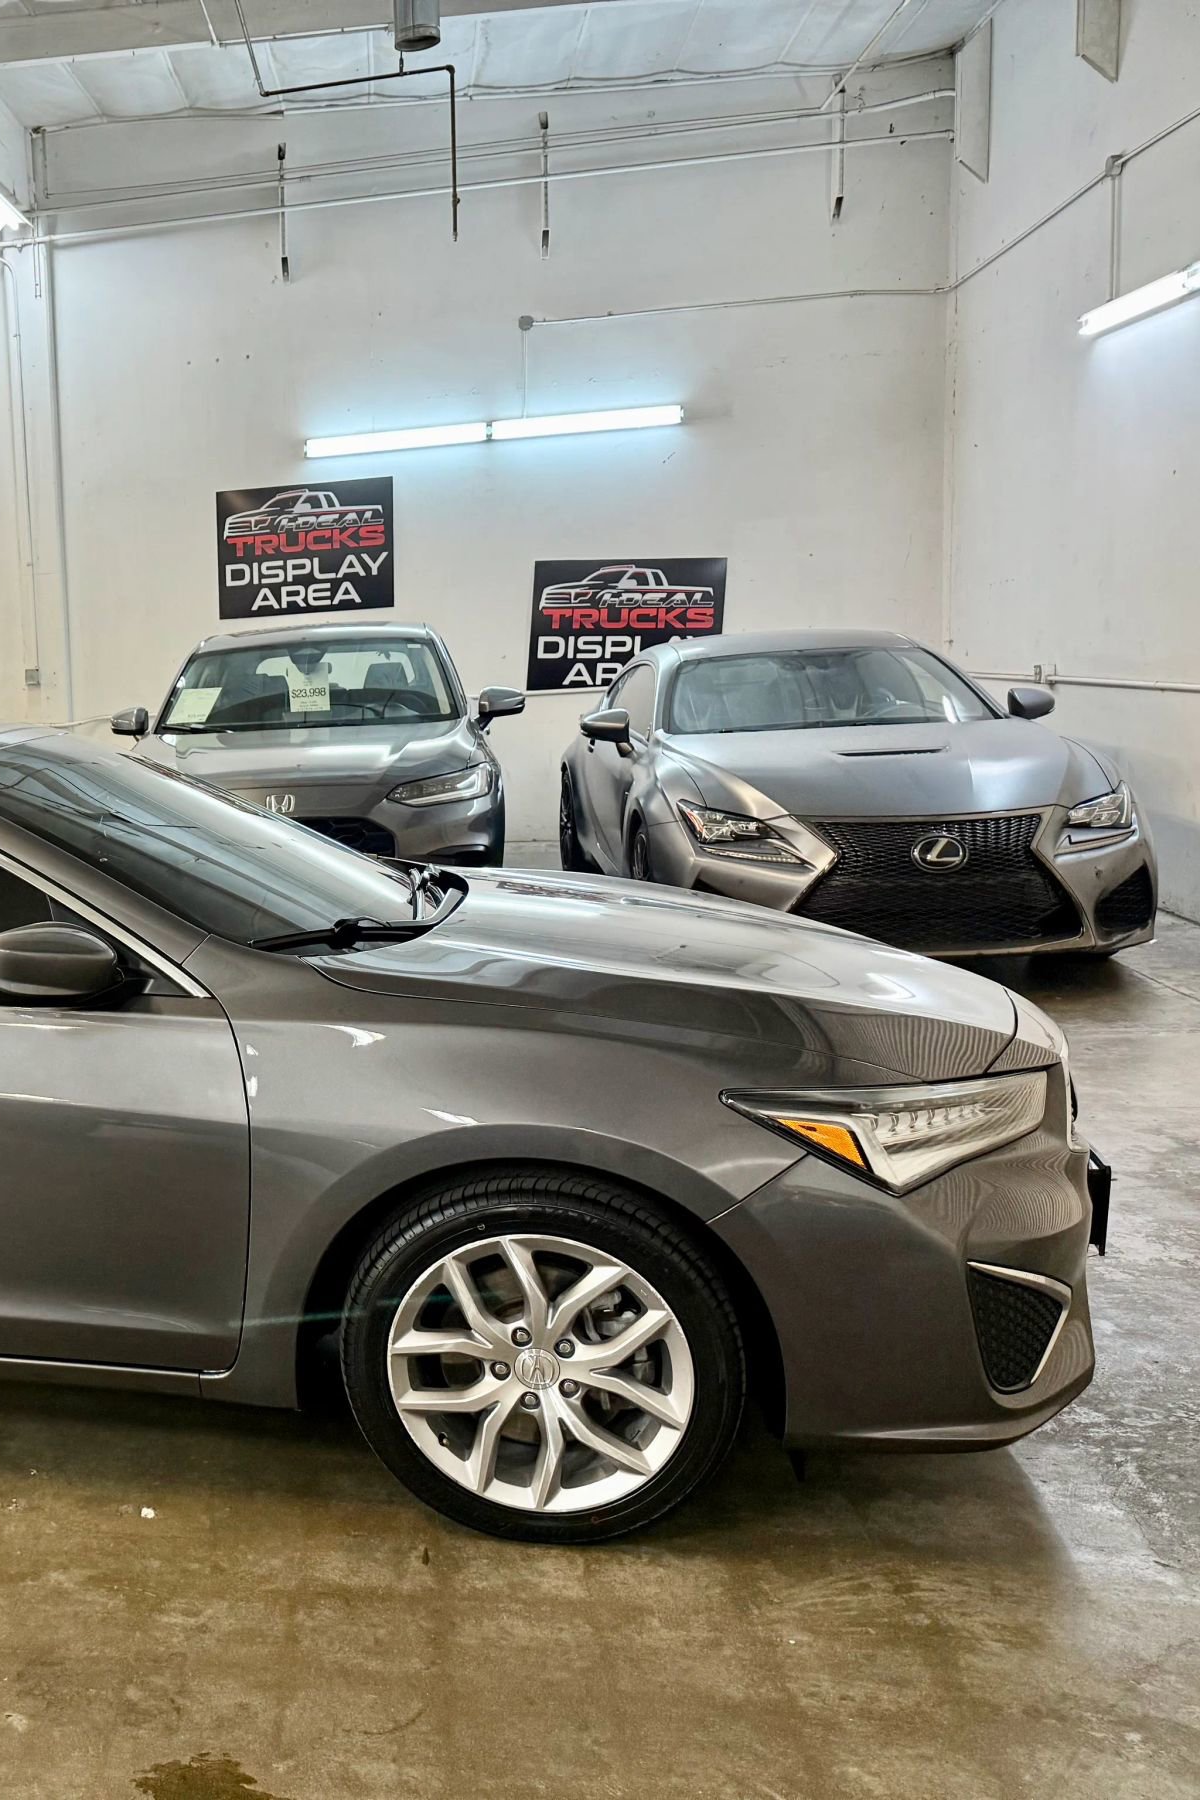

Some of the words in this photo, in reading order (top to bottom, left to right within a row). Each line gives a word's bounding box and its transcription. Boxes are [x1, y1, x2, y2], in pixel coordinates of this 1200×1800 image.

[227, 525, 386, 557] TRUCKS
[225, 551, 389, 587] DISPLAY
[251, 581, 362, 611] AREA
[543, 608, 715, 629] TRUCKS
[291, 687, 327, 699] $23,998
